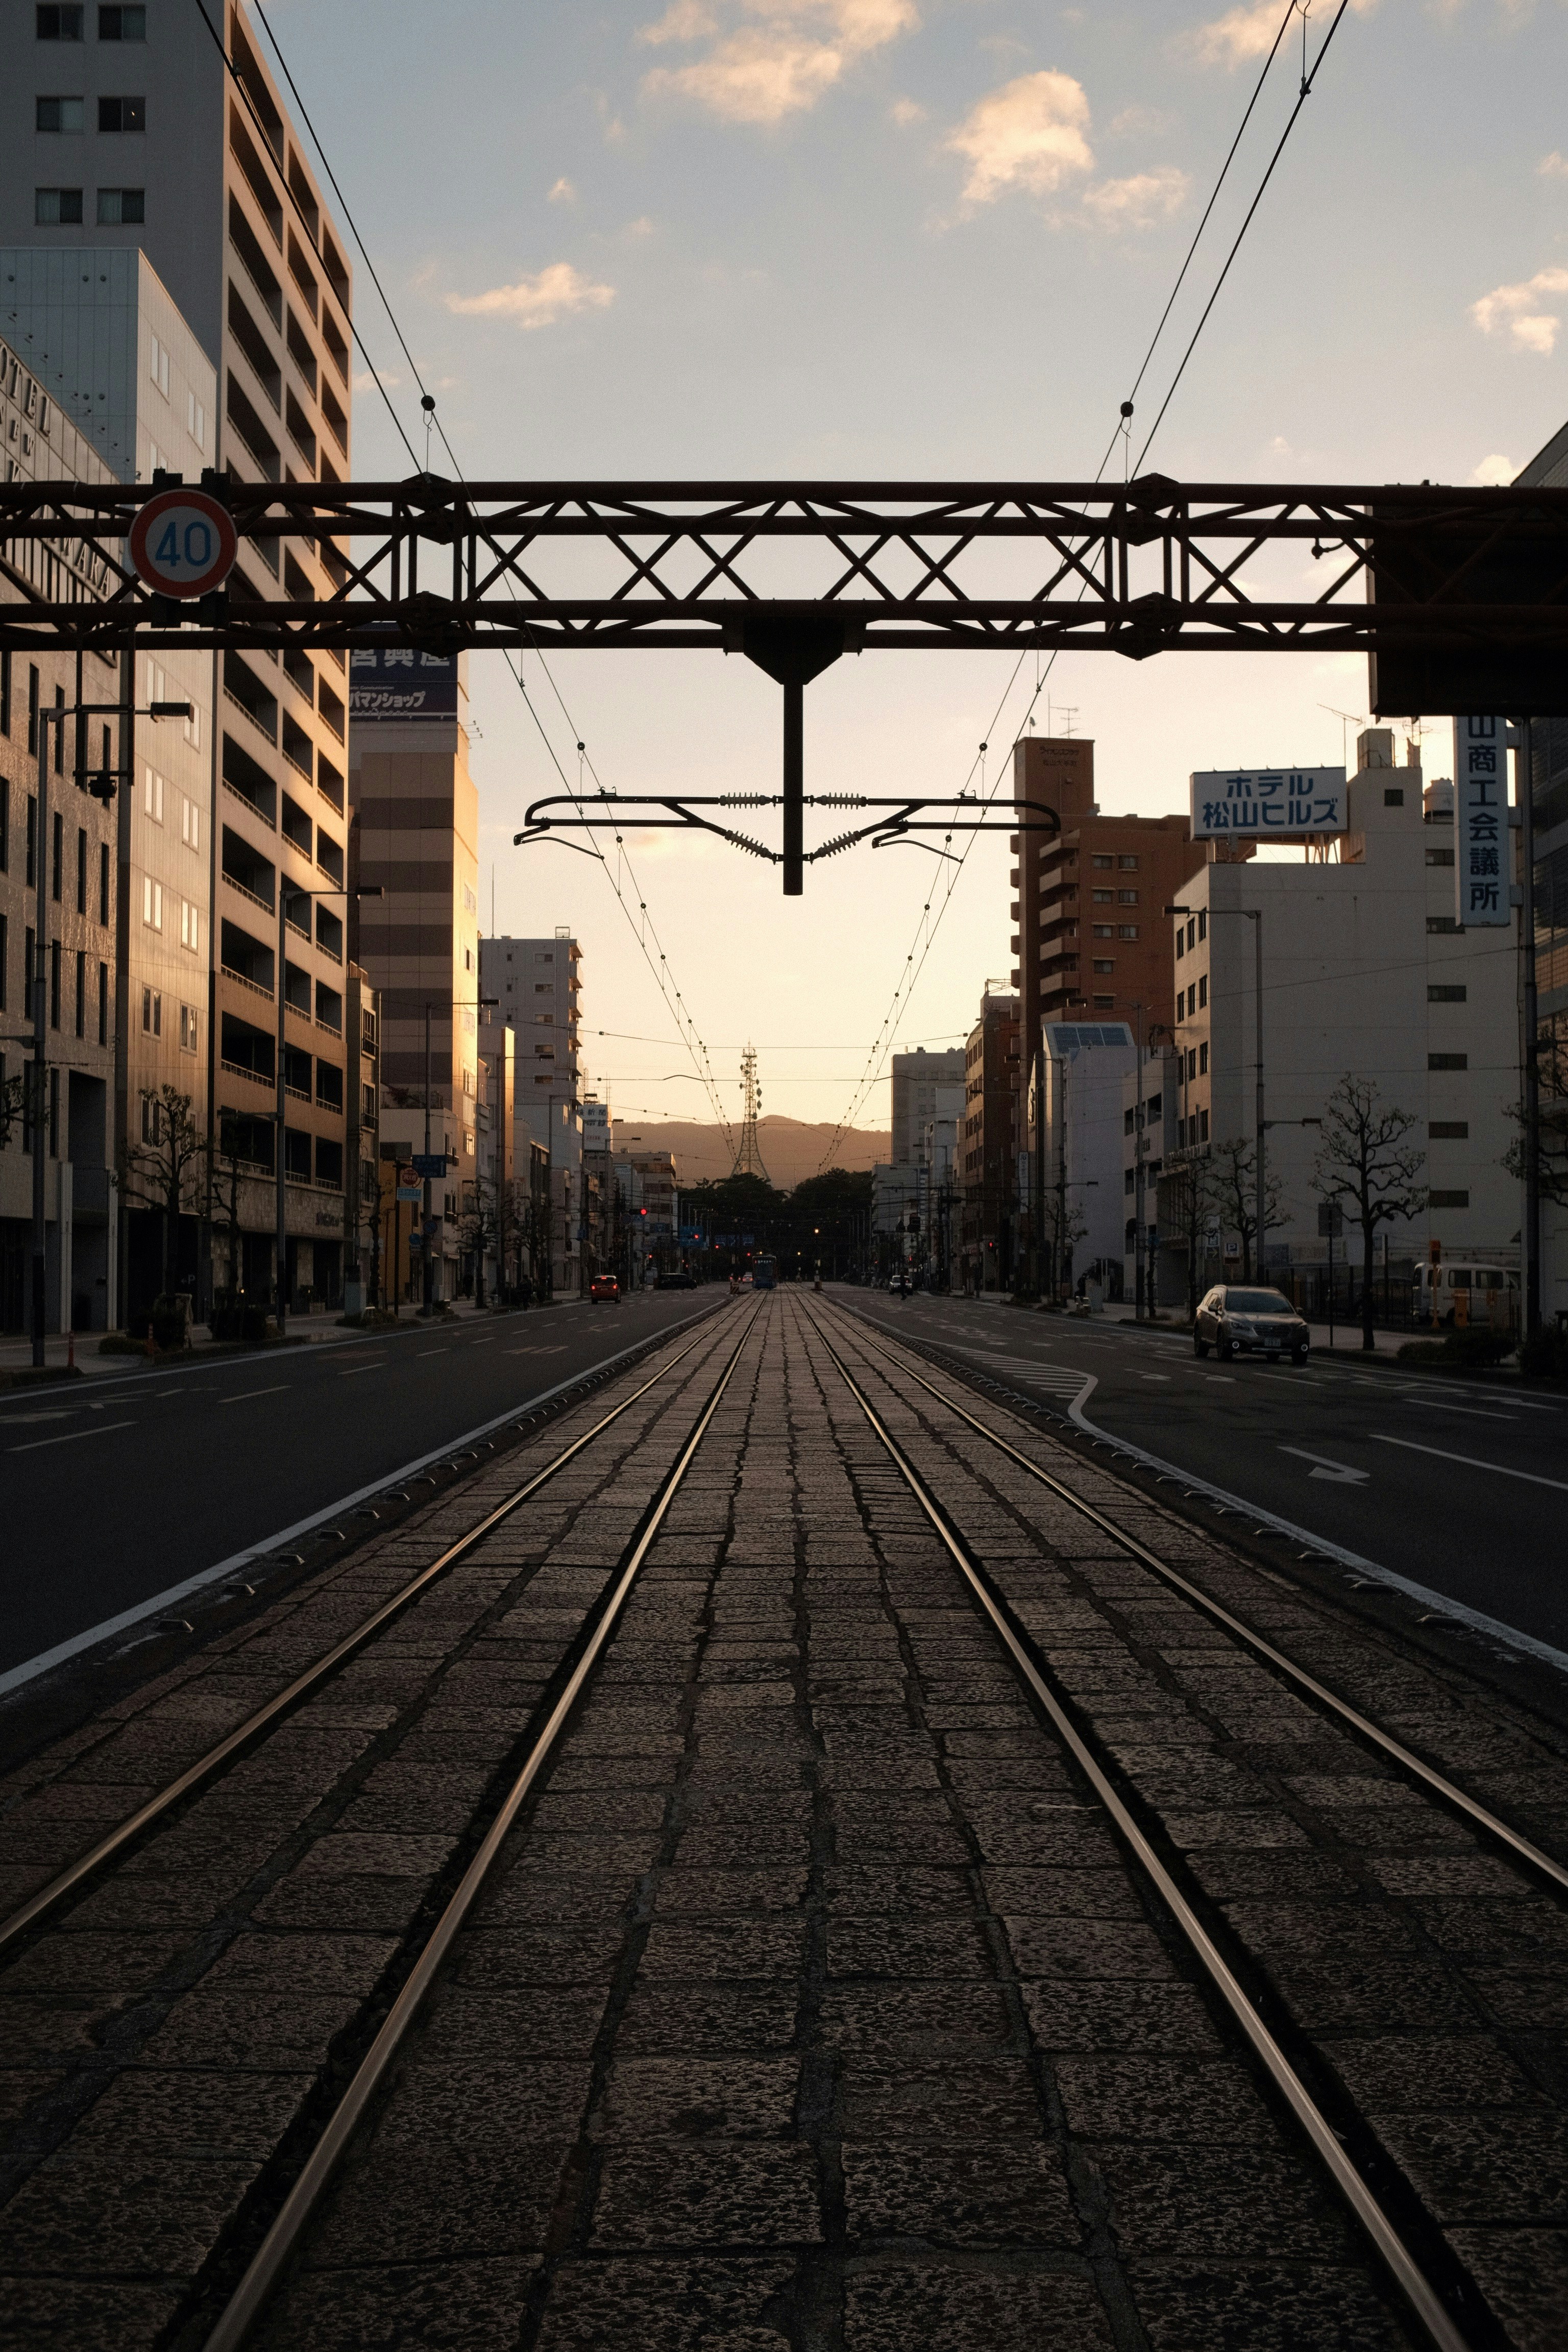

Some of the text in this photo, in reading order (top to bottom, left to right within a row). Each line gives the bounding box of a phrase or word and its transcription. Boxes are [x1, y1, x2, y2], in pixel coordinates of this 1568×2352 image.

[0, 406, 34, 456] EW
[155, 521, 211, 566] 40
[350, 691, 426, 707] パマンショップ
[1227, 775, 1314, 798] ホテル
[1203, 798, 1338, 828] 松山ヒルズ
[1468, 716, 1500, 911] 山商工会議所
[188, 1273, 195, 1284] P
